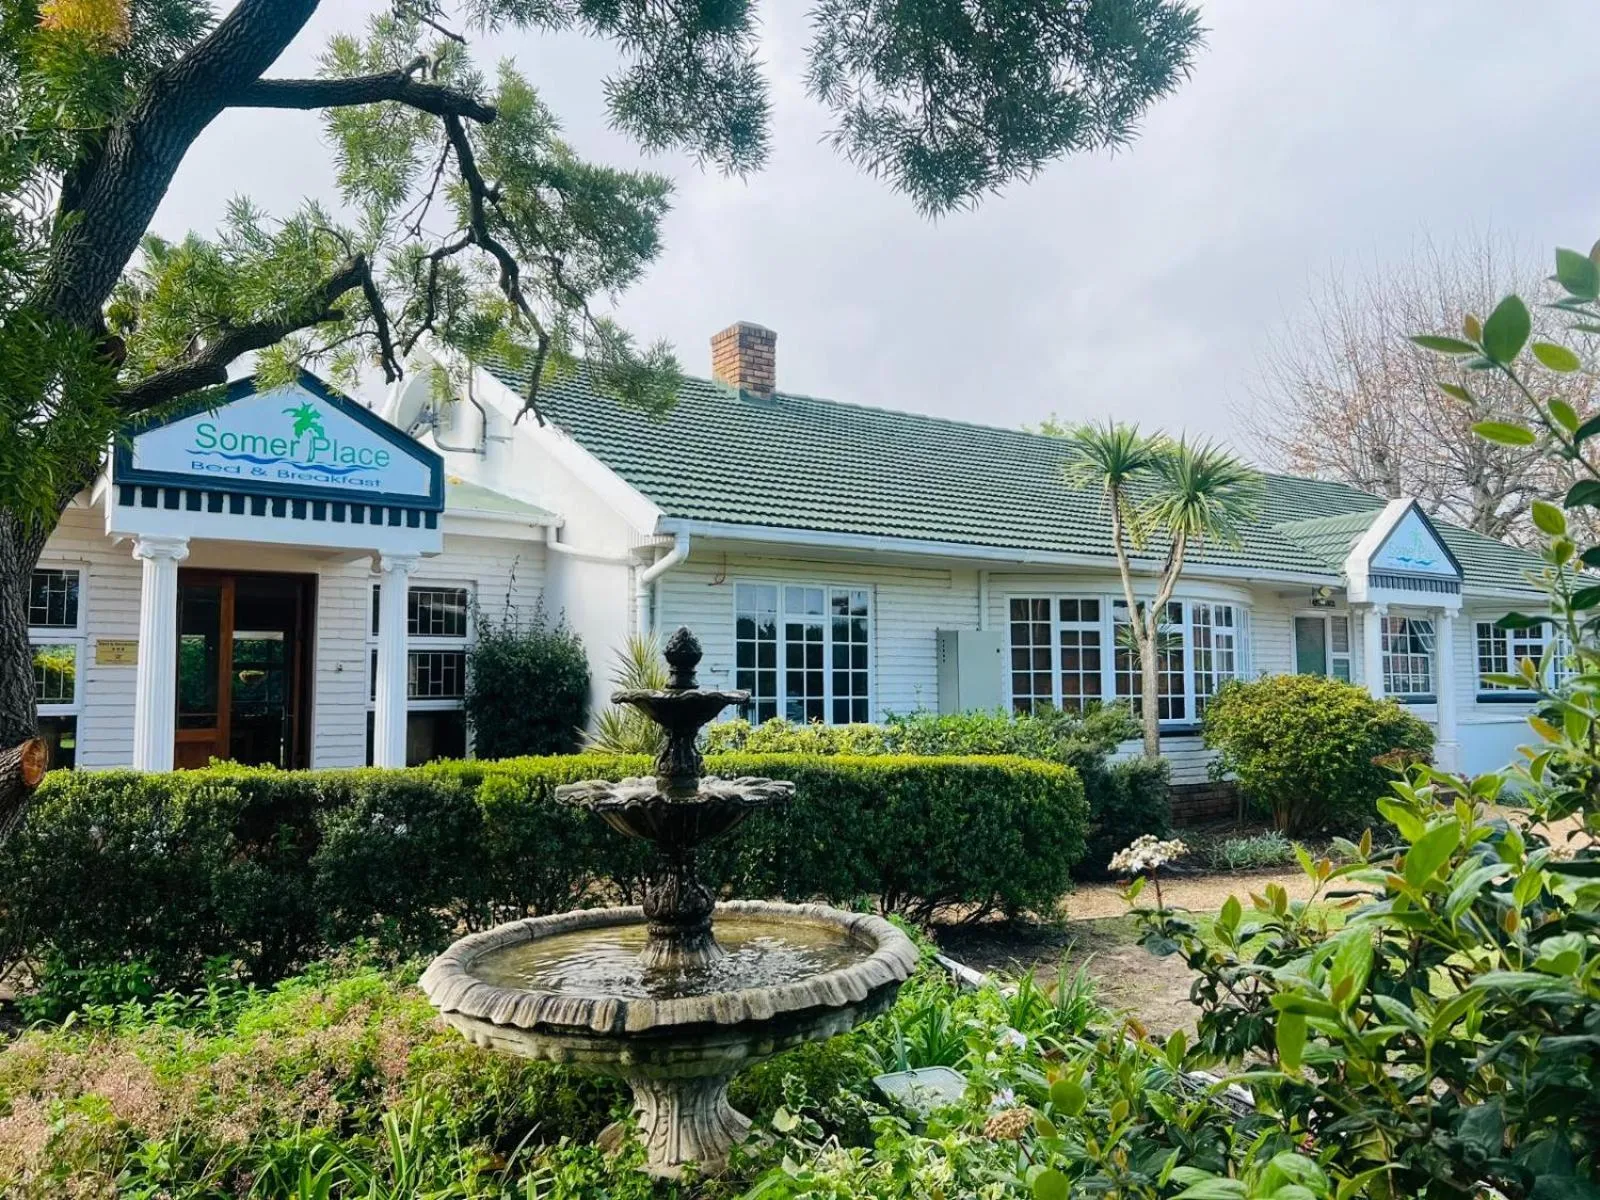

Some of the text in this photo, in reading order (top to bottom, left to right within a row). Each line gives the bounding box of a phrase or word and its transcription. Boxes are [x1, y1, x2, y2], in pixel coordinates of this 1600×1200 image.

[195, 423, 390, 467] Somer Place
[191, 461, 382, 487] Bed & Breakfast
